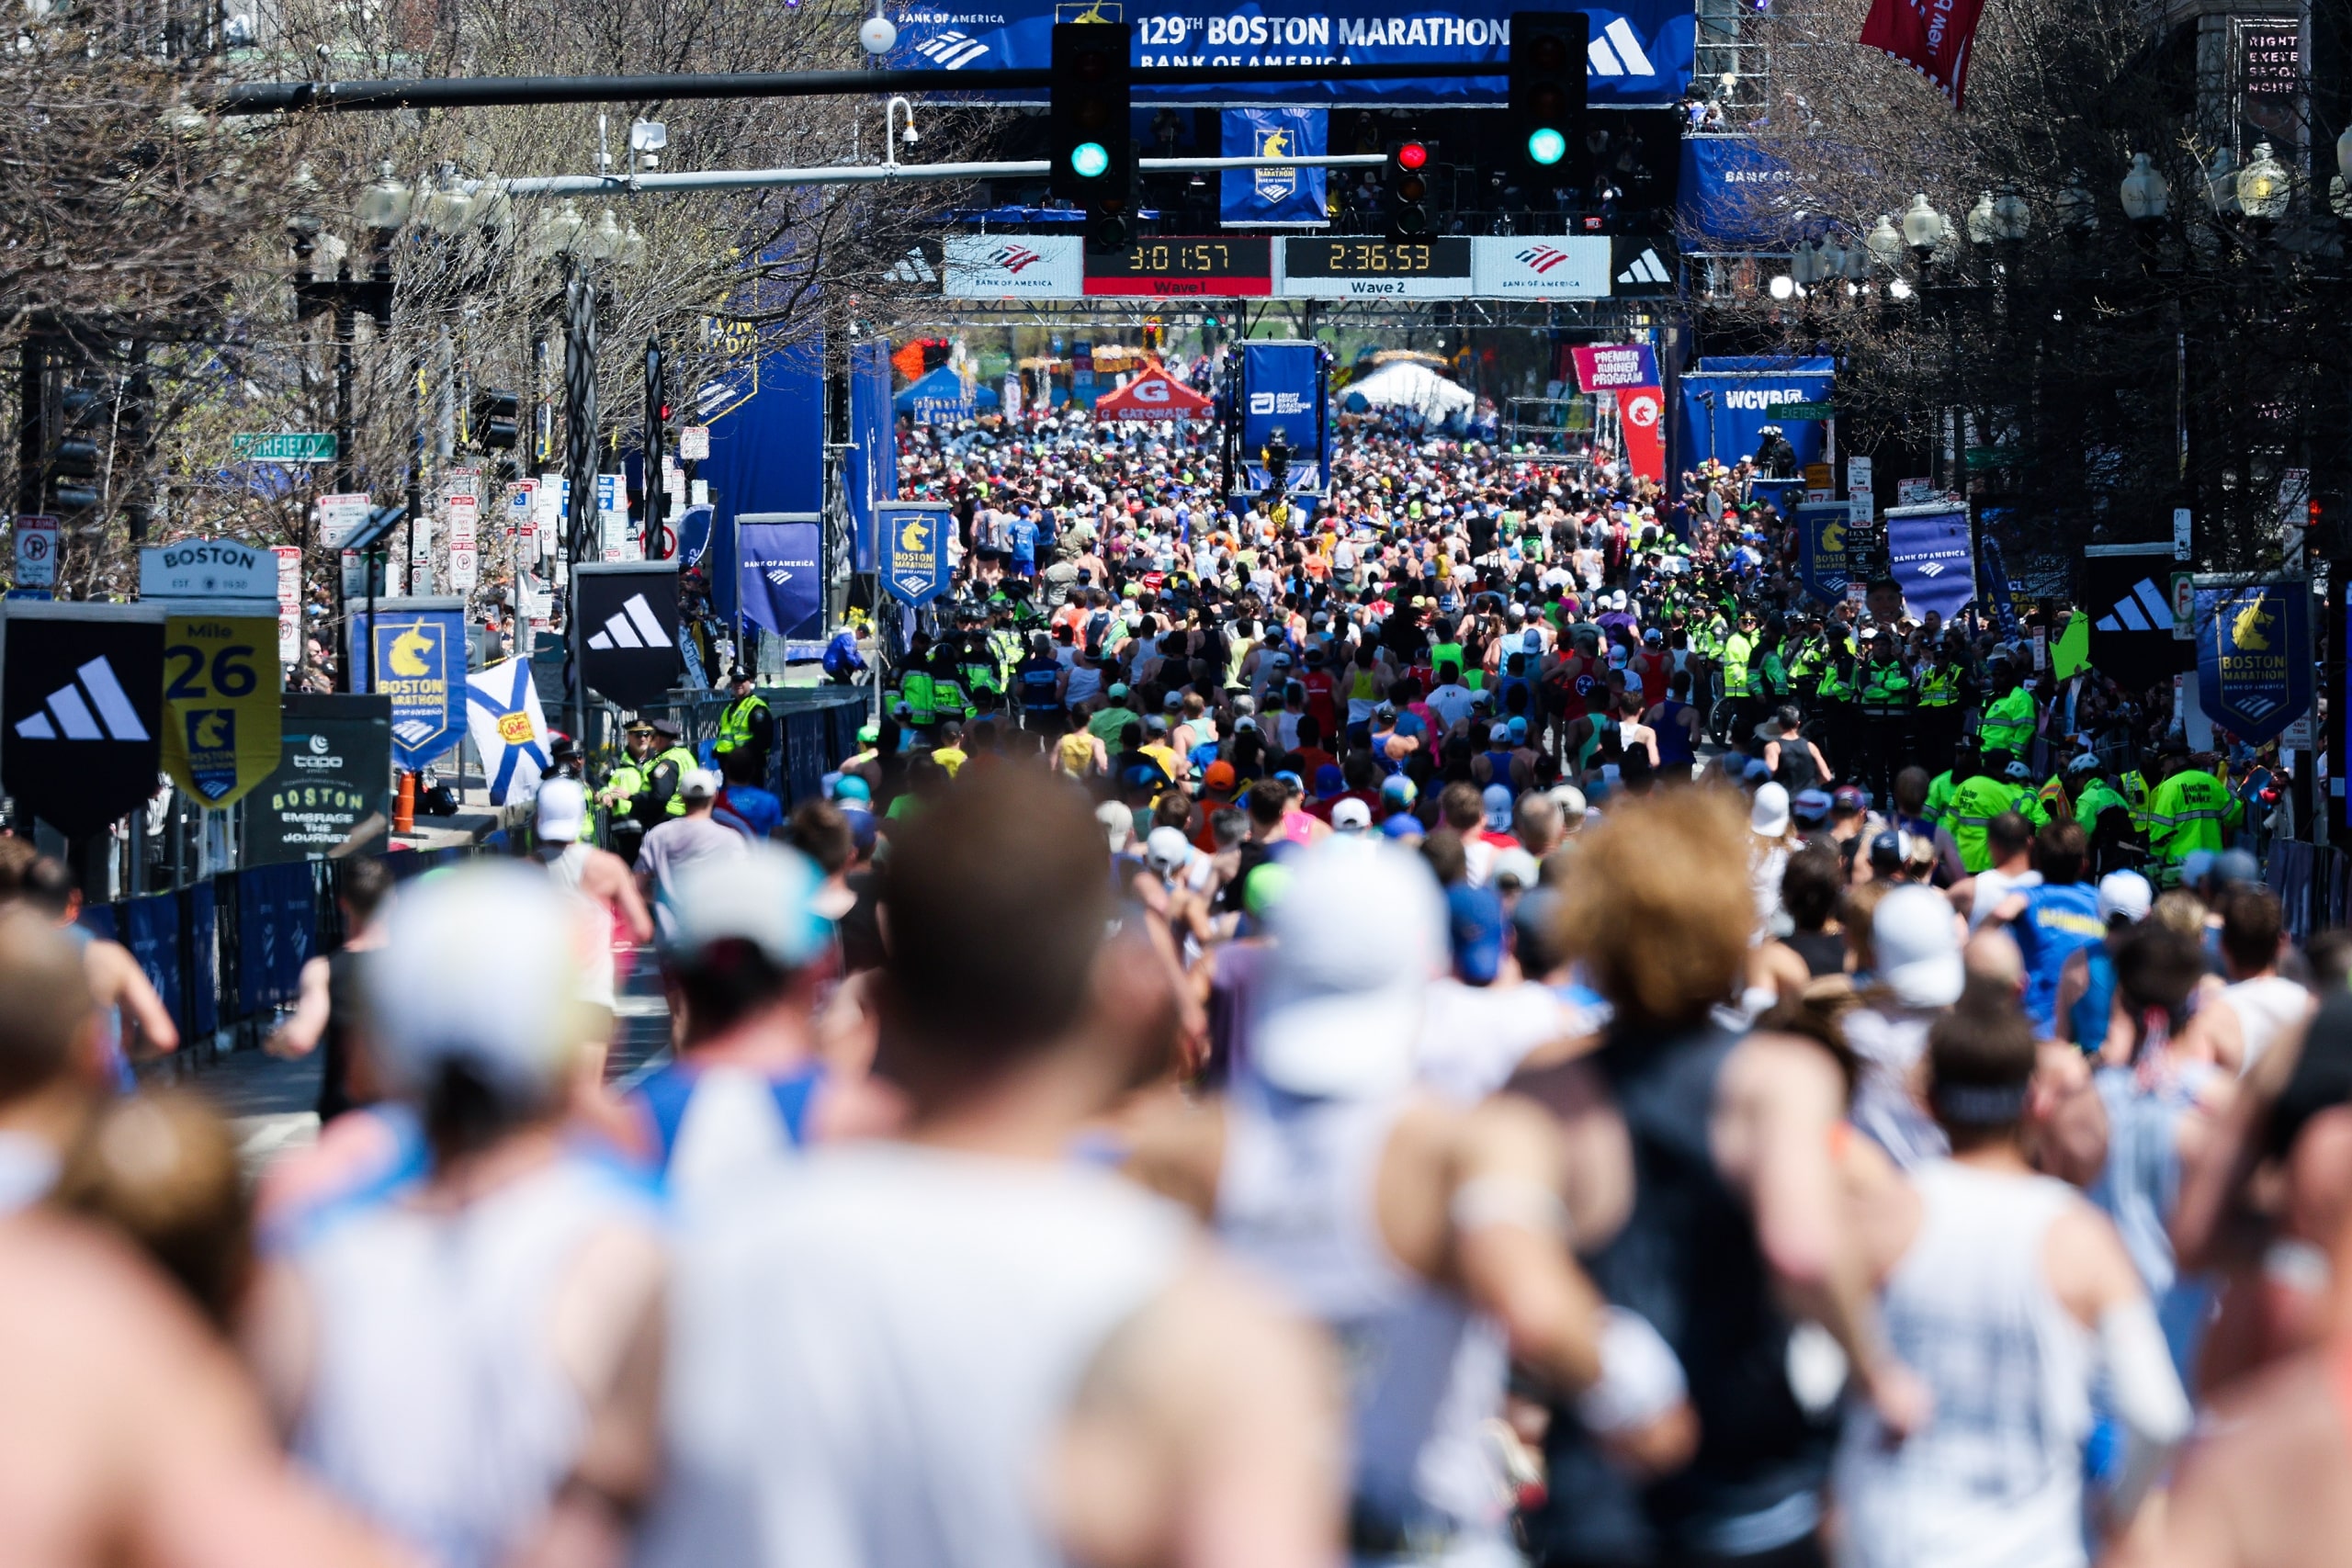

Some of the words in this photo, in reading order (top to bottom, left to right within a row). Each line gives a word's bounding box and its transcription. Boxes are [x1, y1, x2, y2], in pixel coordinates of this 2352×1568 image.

[899, 14, 931, 23] BANK
[933, 14, 949, 23] OF
[951, 15, 1005, 24] AMERICA
[1208, 15, 1329, 45] BOSTON
[1339, 17, 1510, 46] MARATHON
[1141, 55, 1205, 67] BANK
[1213, 55, 1241, 67] OF
[1725, 171, 1769, 183] BANK
[1130, 245, 1228, 271] 3:01:57
[1330, 243, 1430, 271] 2:36:53
[1154, 281, 1198, 293] Wave
[1351, 282, 1394, 293] Wave
[1396, 282, 1405, 293] 2
[1594, 350, 1639, 364] PREMIER
[1597, 361, 1638, 373] RUNNER
[1591, 372, 1643, 386] PROGRAM
[1133, 379, 1170, 402] G
[1725, 389, 1783, 410] WCVB
[1781, 407, 1816, 419] EXETER
[164, 547, 255, 570] BOSTON
[895, 552, 933, 562] BOSTON
[1815, 553, 1847, 564] BOSTO
[1894, 554, 1917, 563] BANK
[1917, 552, 1928, 560] OF
[1929, 550, 1965, 559] AMERICA
[895, 560, 933, 570] MARATHON
[187, 624, 232, 639] Mile
[2222, 656, 2285, 670] BOSTON
[165, 645, 257, 697] 26
[2222, 671, 2286, 681] MARATHON
[379, 679, 443, 694] BOSTON
[390, 694, 444, 705] ARATHON
[272, 787, 364, 810] BOSTON
[281, 812, 355, 824] EMBRACE
[303, 823, 332, 833] THE
[281, 832, 353, 843] JOURNEY
